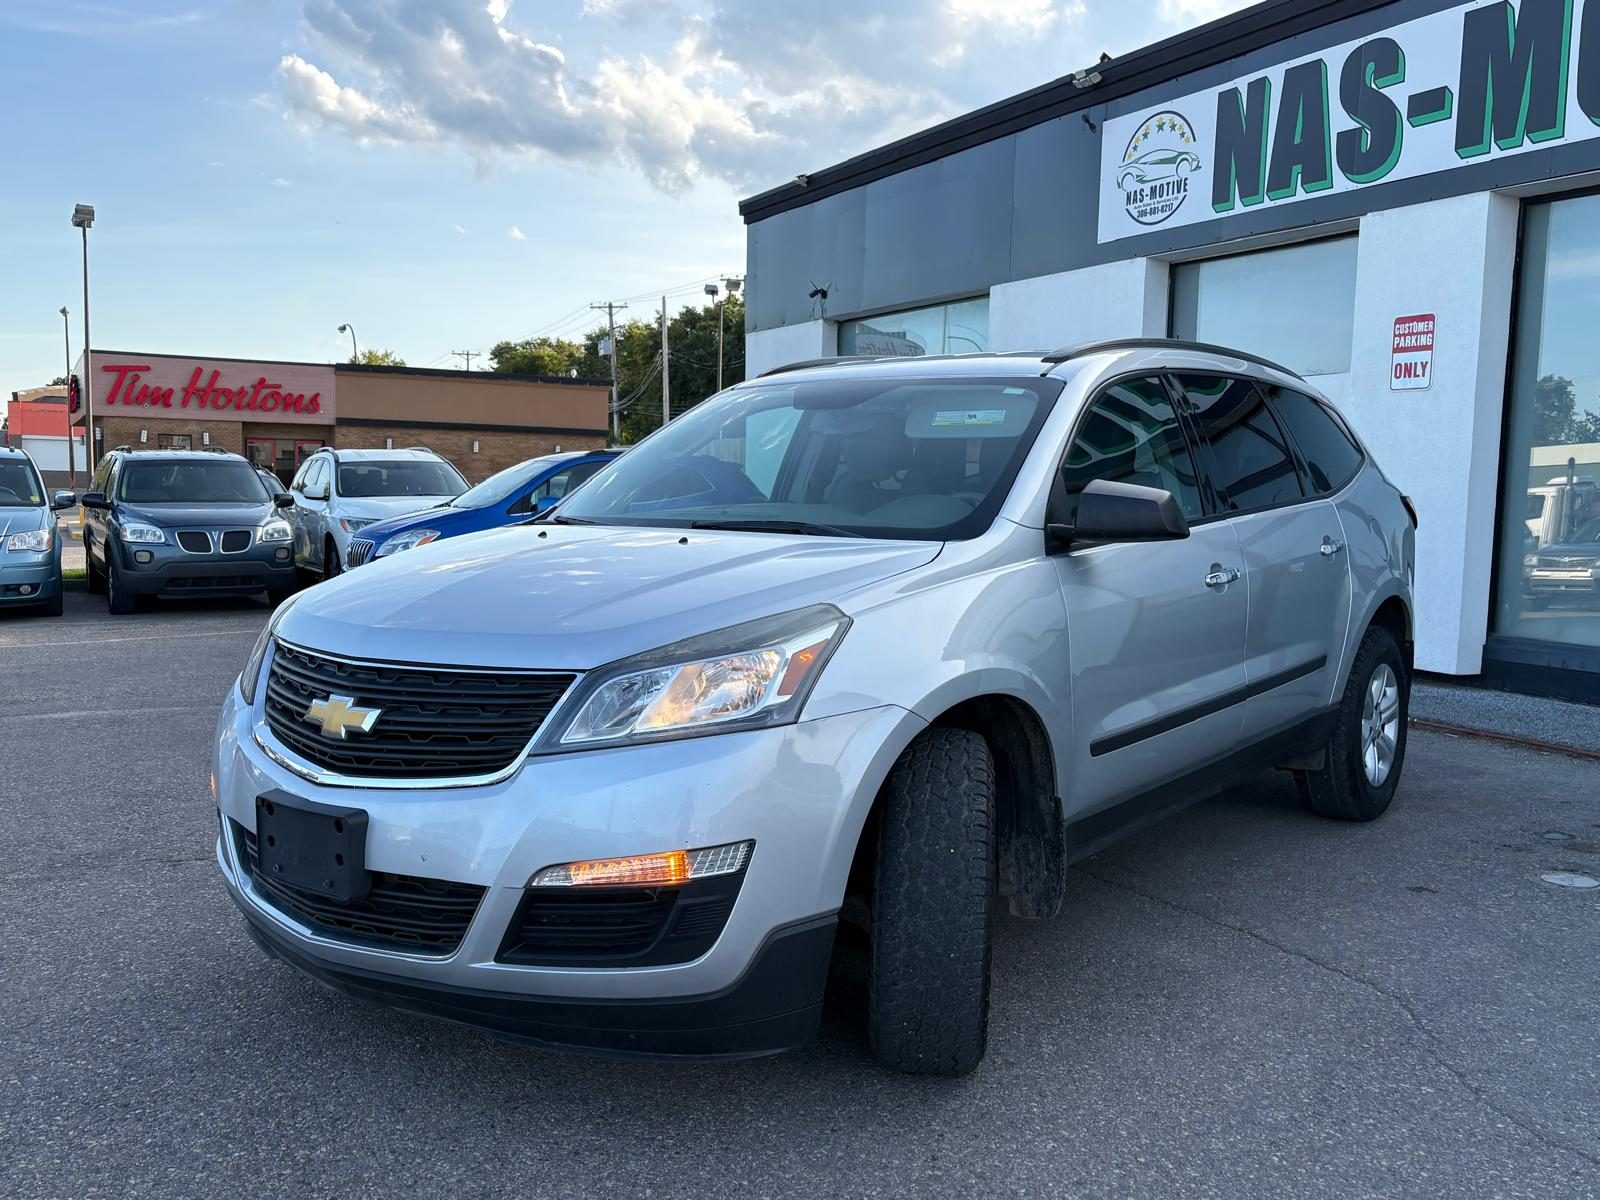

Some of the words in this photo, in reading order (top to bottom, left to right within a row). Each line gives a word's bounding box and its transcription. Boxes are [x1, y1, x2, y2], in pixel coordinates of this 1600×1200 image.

[1126, 177, 1188, 206] NAS-MOTIVE
[1395, 321, 1433, 334] CUSTOMER
[1394, 334, 1432, 348] PARKING
[1394, 361, 1429, 380] ONLY
[102, 365, 174, 408] Tim
[181, 366, 321, 414] Hortons
